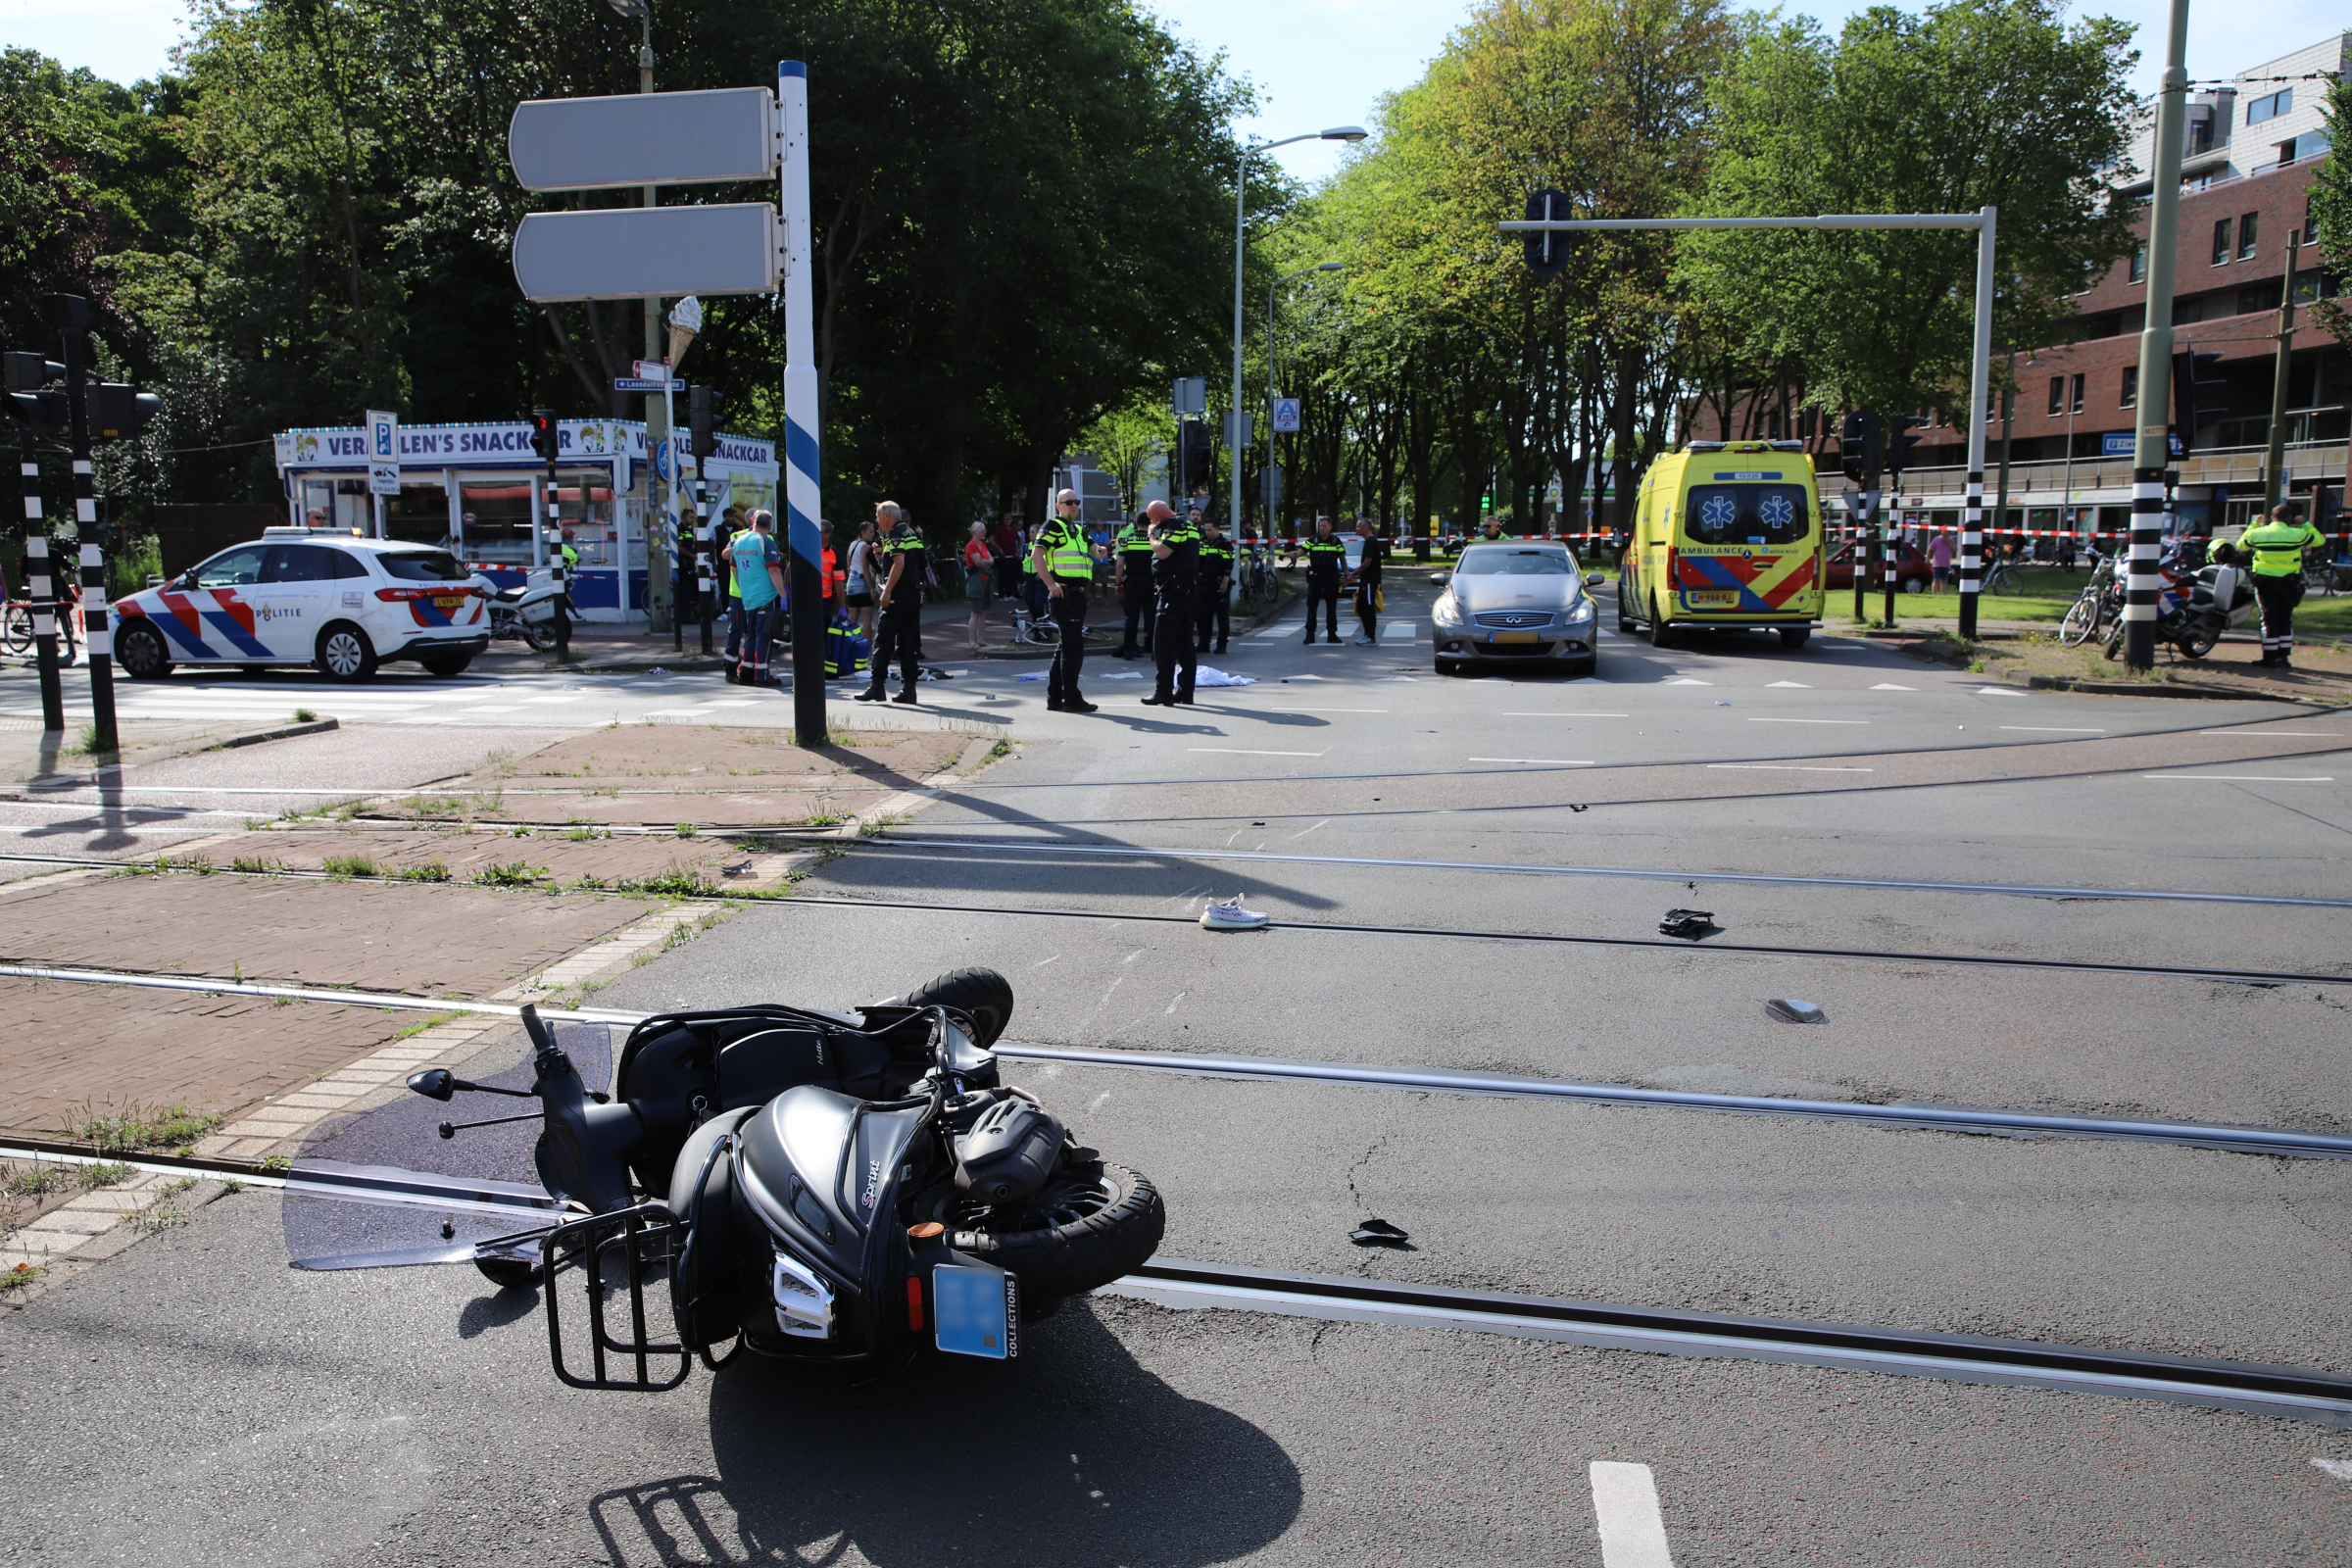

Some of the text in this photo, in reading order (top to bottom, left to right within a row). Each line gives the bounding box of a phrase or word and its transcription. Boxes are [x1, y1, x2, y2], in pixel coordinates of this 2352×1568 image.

[328, 430, 571, 456] VERLEN'S SNACKR
[257, 609, 301, 621] POLITIE
[861, 1159, 881, 1209] Sprint
[1006, 1280, 1018, 1357] COLLECTIONS
